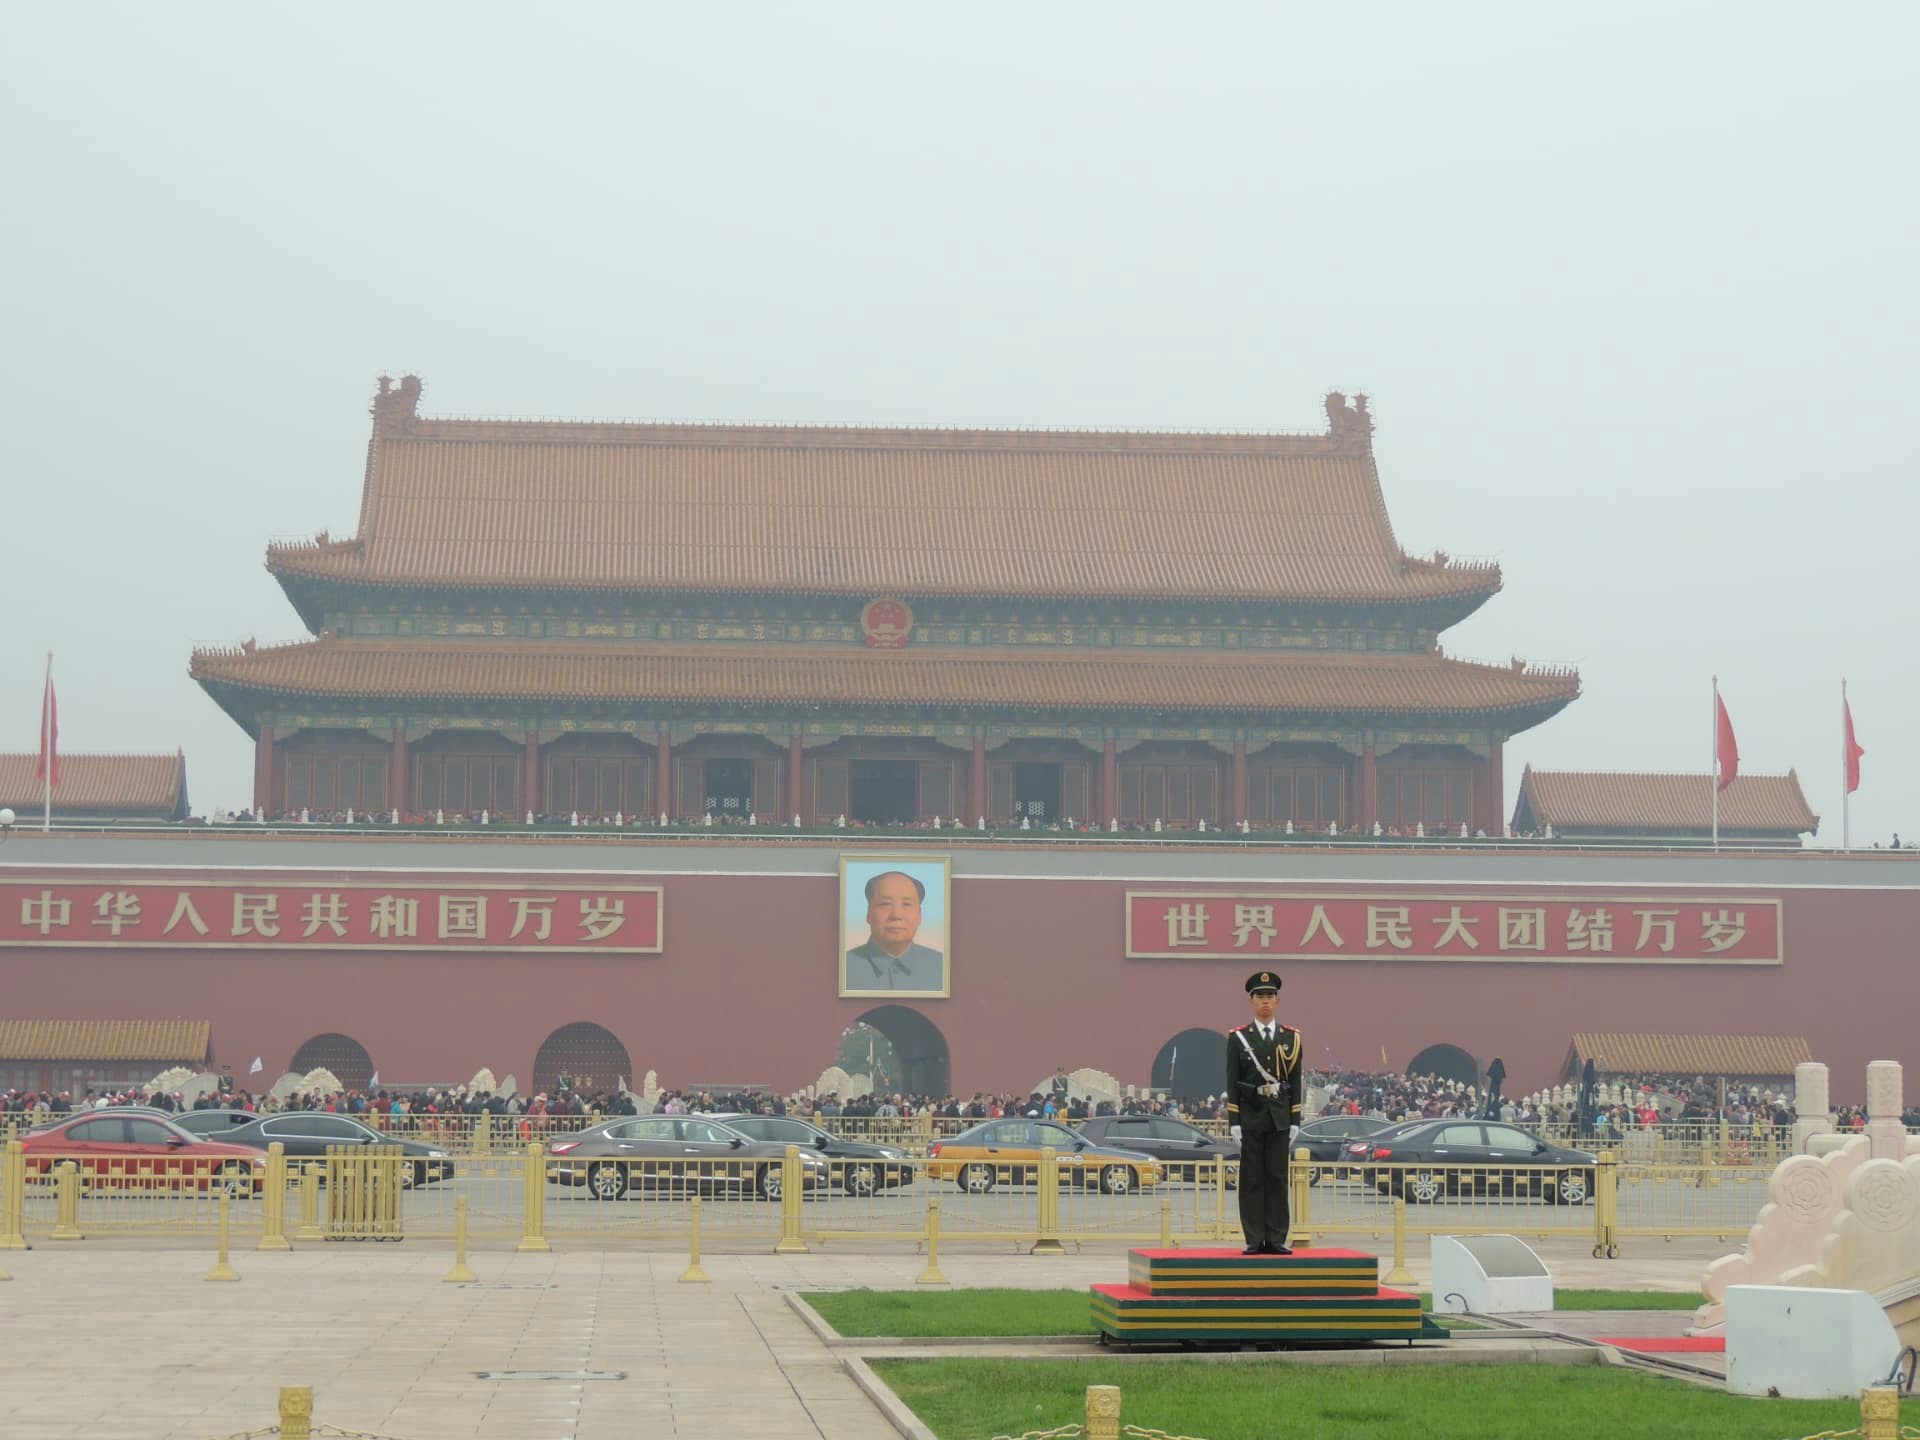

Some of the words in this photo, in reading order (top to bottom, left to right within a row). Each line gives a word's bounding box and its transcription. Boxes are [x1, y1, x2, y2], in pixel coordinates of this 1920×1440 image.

[20, 890, 627, 941] 中华人民共和国万岁
[1162, 902, 1747, 953] 世界人民大团结万岁
